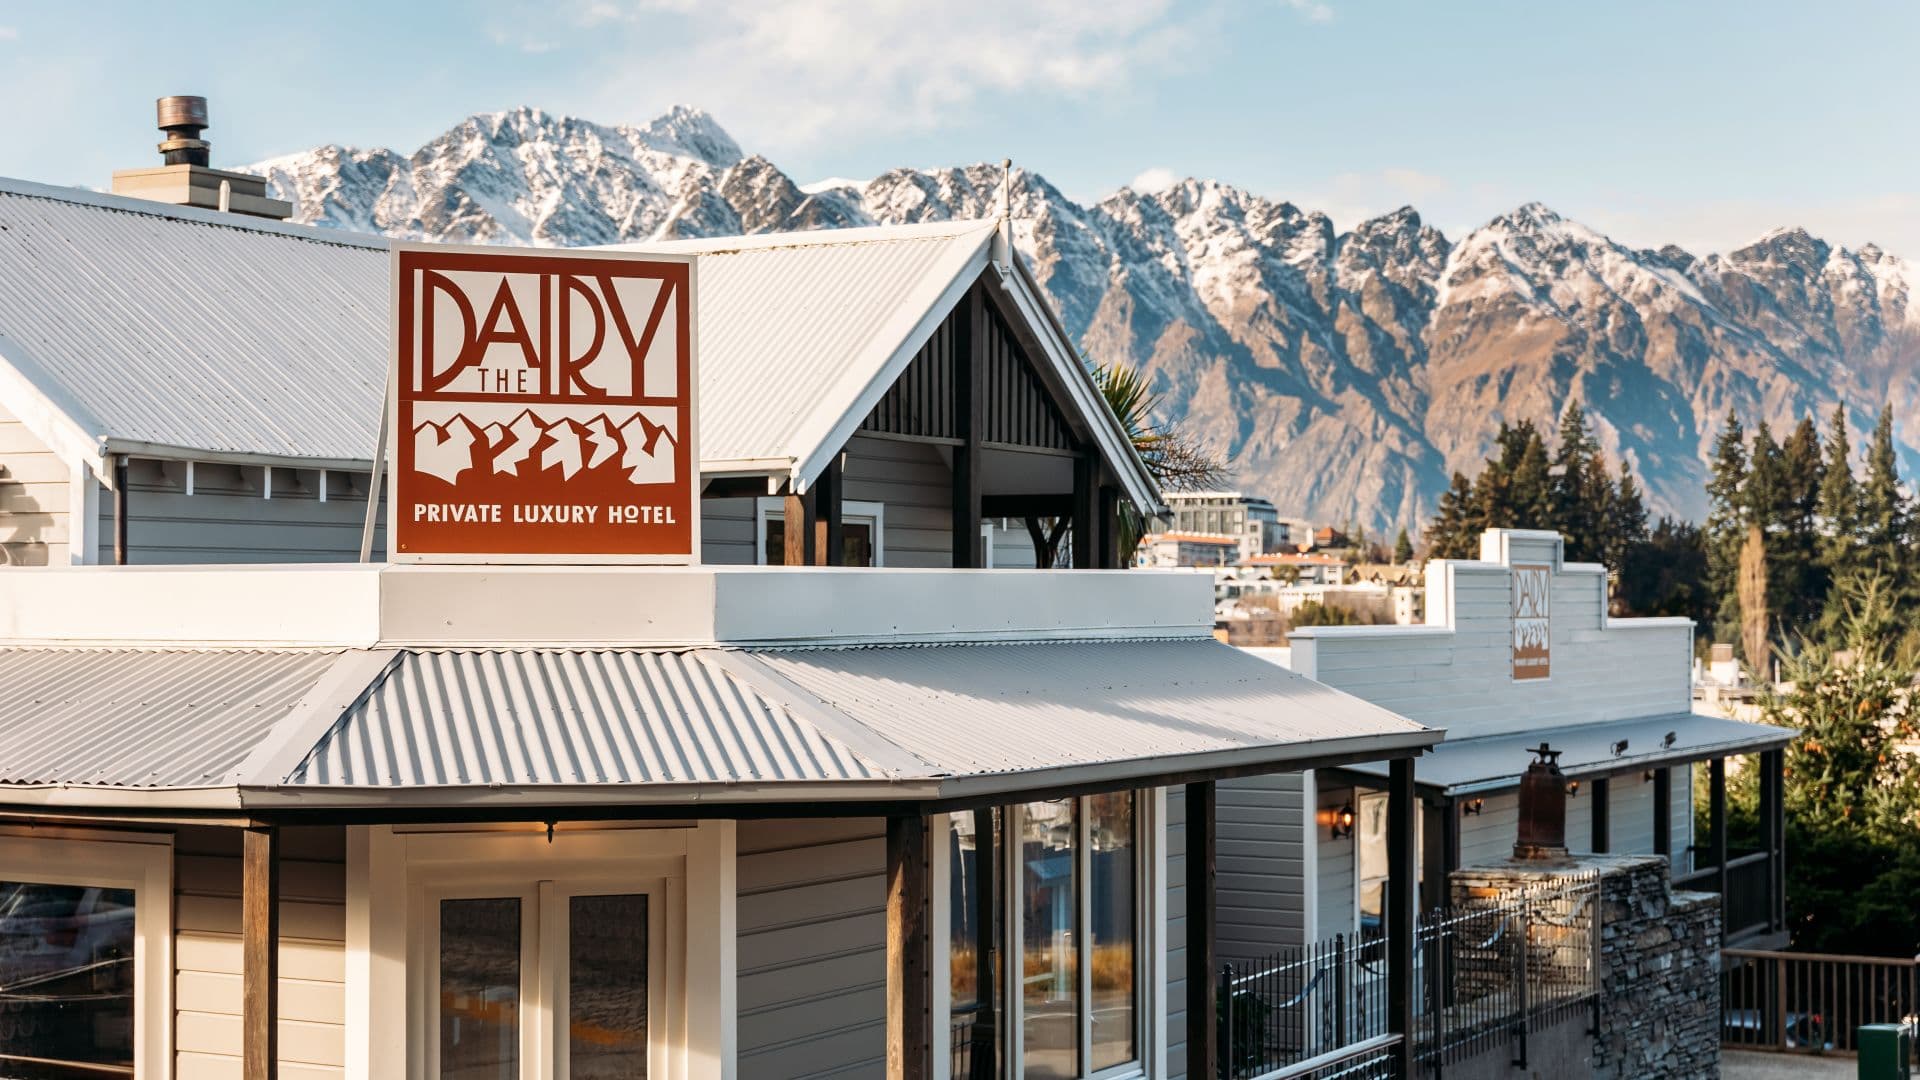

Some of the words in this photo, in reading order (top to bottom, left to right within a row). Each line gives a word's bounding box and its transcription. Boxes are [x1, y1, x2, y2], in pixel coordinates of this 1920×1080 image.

[421, 269, 677, 398] DAIRY
[477, 368, 528, 393] THE
[413, 503, 502, 523] PRIVATE
[512, 504, 599, 524] LUXURY
[607, 505, 676, 525] HOTEL
